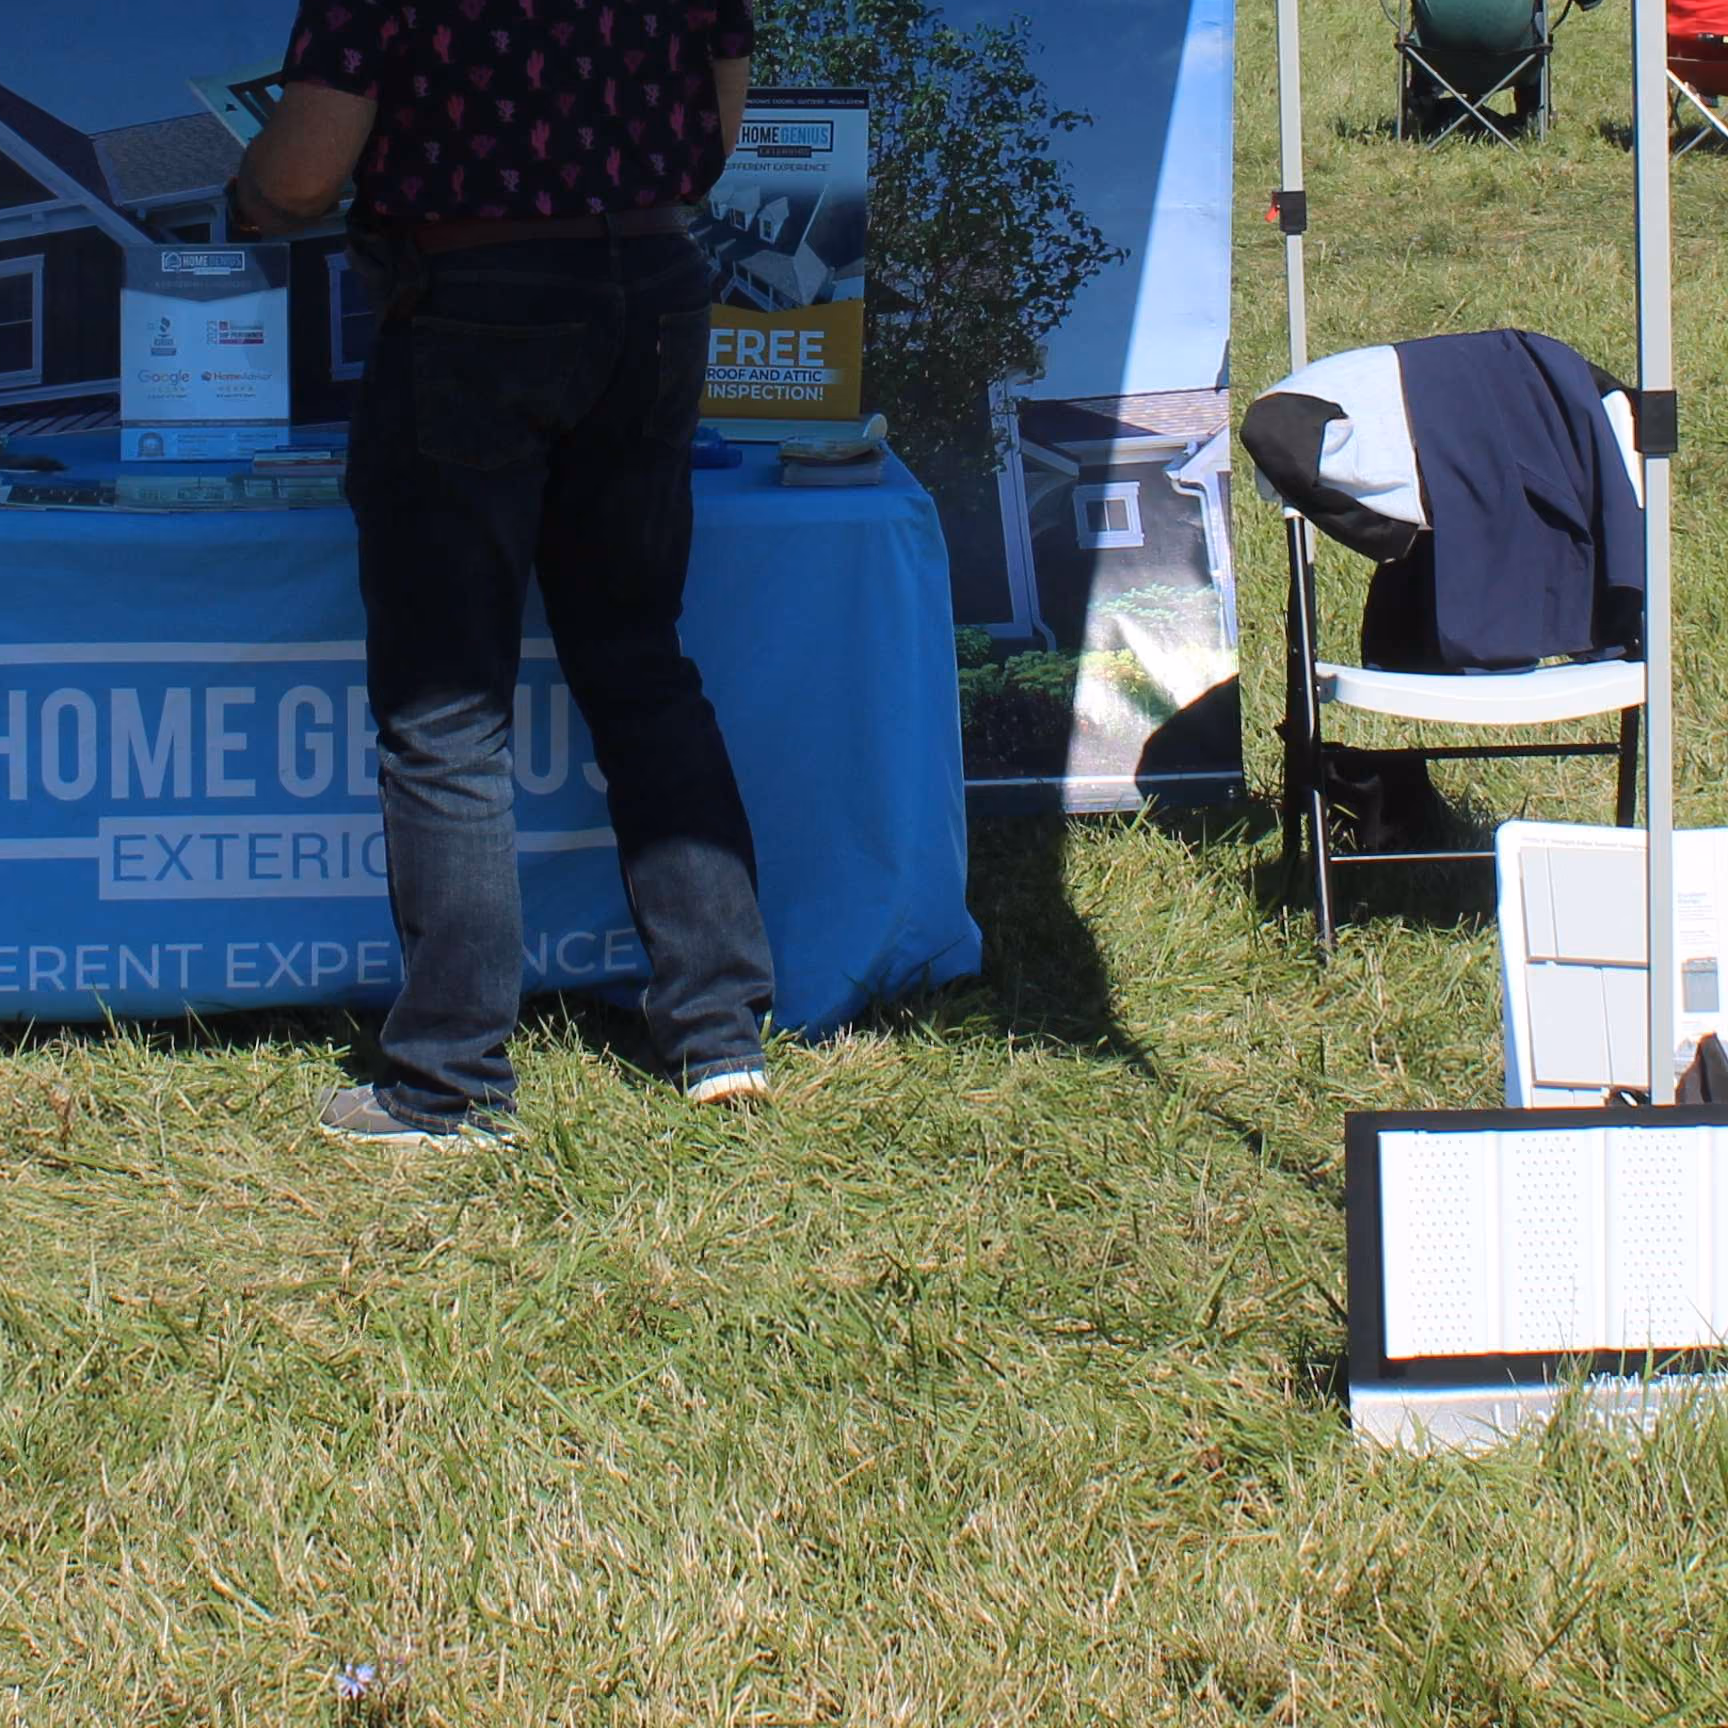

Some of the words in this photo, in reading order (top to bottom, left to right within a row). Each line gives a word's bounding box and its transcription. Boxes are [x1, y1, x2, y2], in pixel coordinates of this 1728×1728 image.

[741, 126, 780, 144] HOME
[780, 126, 829, 145] GENIUS
[182, 256, 209, 267] HOME
[706, 329, 826, 367] FREE
[138, 369, 190, 386] Google
[706, 368, 746, 382] ROOF
[747, 368, 781, 382] AND
[783, 368, 823, 382] ATTIC
[707, 383, 825, 402] INSPECTION!
